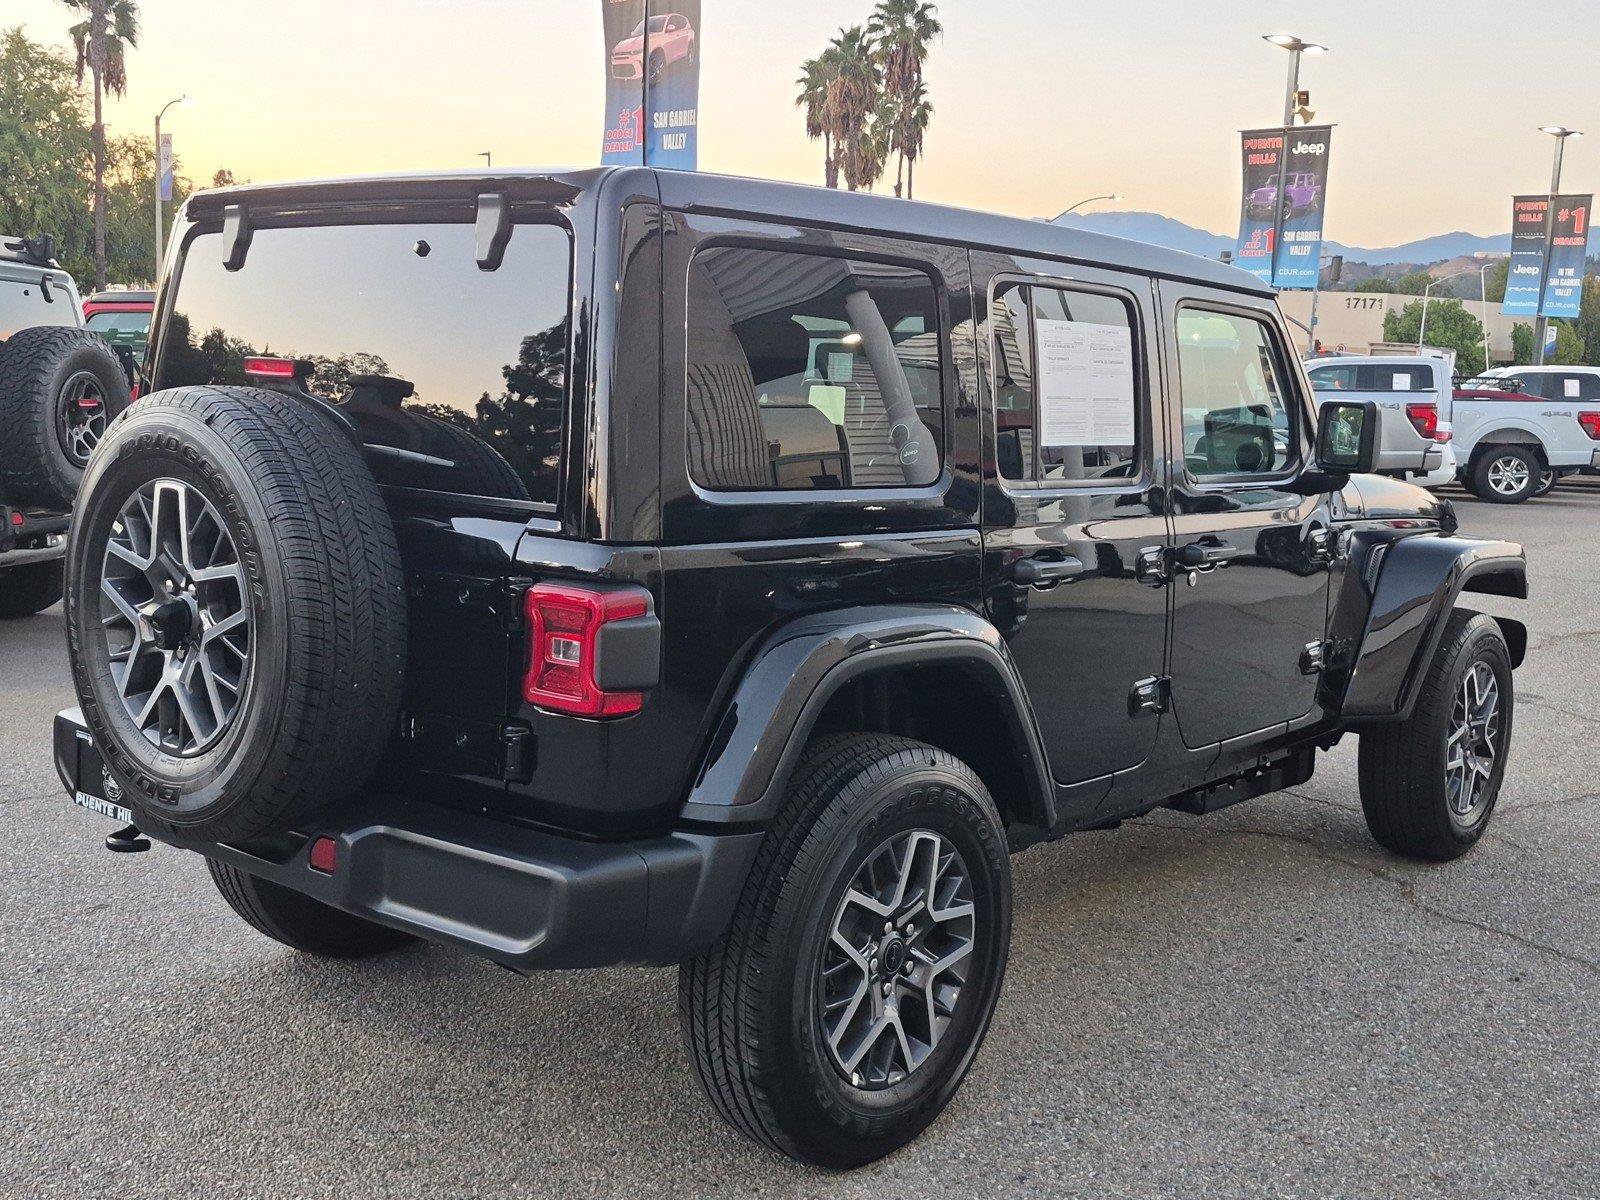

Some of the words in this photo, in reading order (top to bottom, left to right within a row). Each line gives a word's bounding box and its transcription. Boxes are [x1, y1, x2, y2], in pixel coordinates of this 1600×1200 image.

[653, 111, 668, 129] SAN
[668, 109, 697, 127] GABRIEL
[604, 141, 634, 153] DEALER
[663, 132, 687, 150] VALLEY
[1243, 137, 1283, 150] PUENTE
[1291, 141, 1325, 156] Jeep
[1248, 152, 1277, 165] HILLS
[1514, 201, 1548, 211] PUENTE
[1518, 213, 1543, 222] HILLS
[1558, 206, 1586, 234] #1
[1251, 227, 1275, 254] #1
[1283, 231, 1296, 242] SAN
[1296, 230, 1320, 242] GABRIEL
[1553, 236, 1586, 246] DEALER
[1289, 245, 1311, 256] VALLEY
[1278, 268, 1315, 276] CDJR.com
[1512, 264, 1540, 276] Jeep
[1557, 268, 1564, 276] IN
[1565, 268, 1575, 276] THE
[1549, 277, 1560, 286] SAN
[1560, 278, 1581, 287] GABRIEL
[1555, 288, 1573, 296] VALLEY
[1345, 297, 1383, 310] 17171
[76, 791, 114, 817] PUENTE
